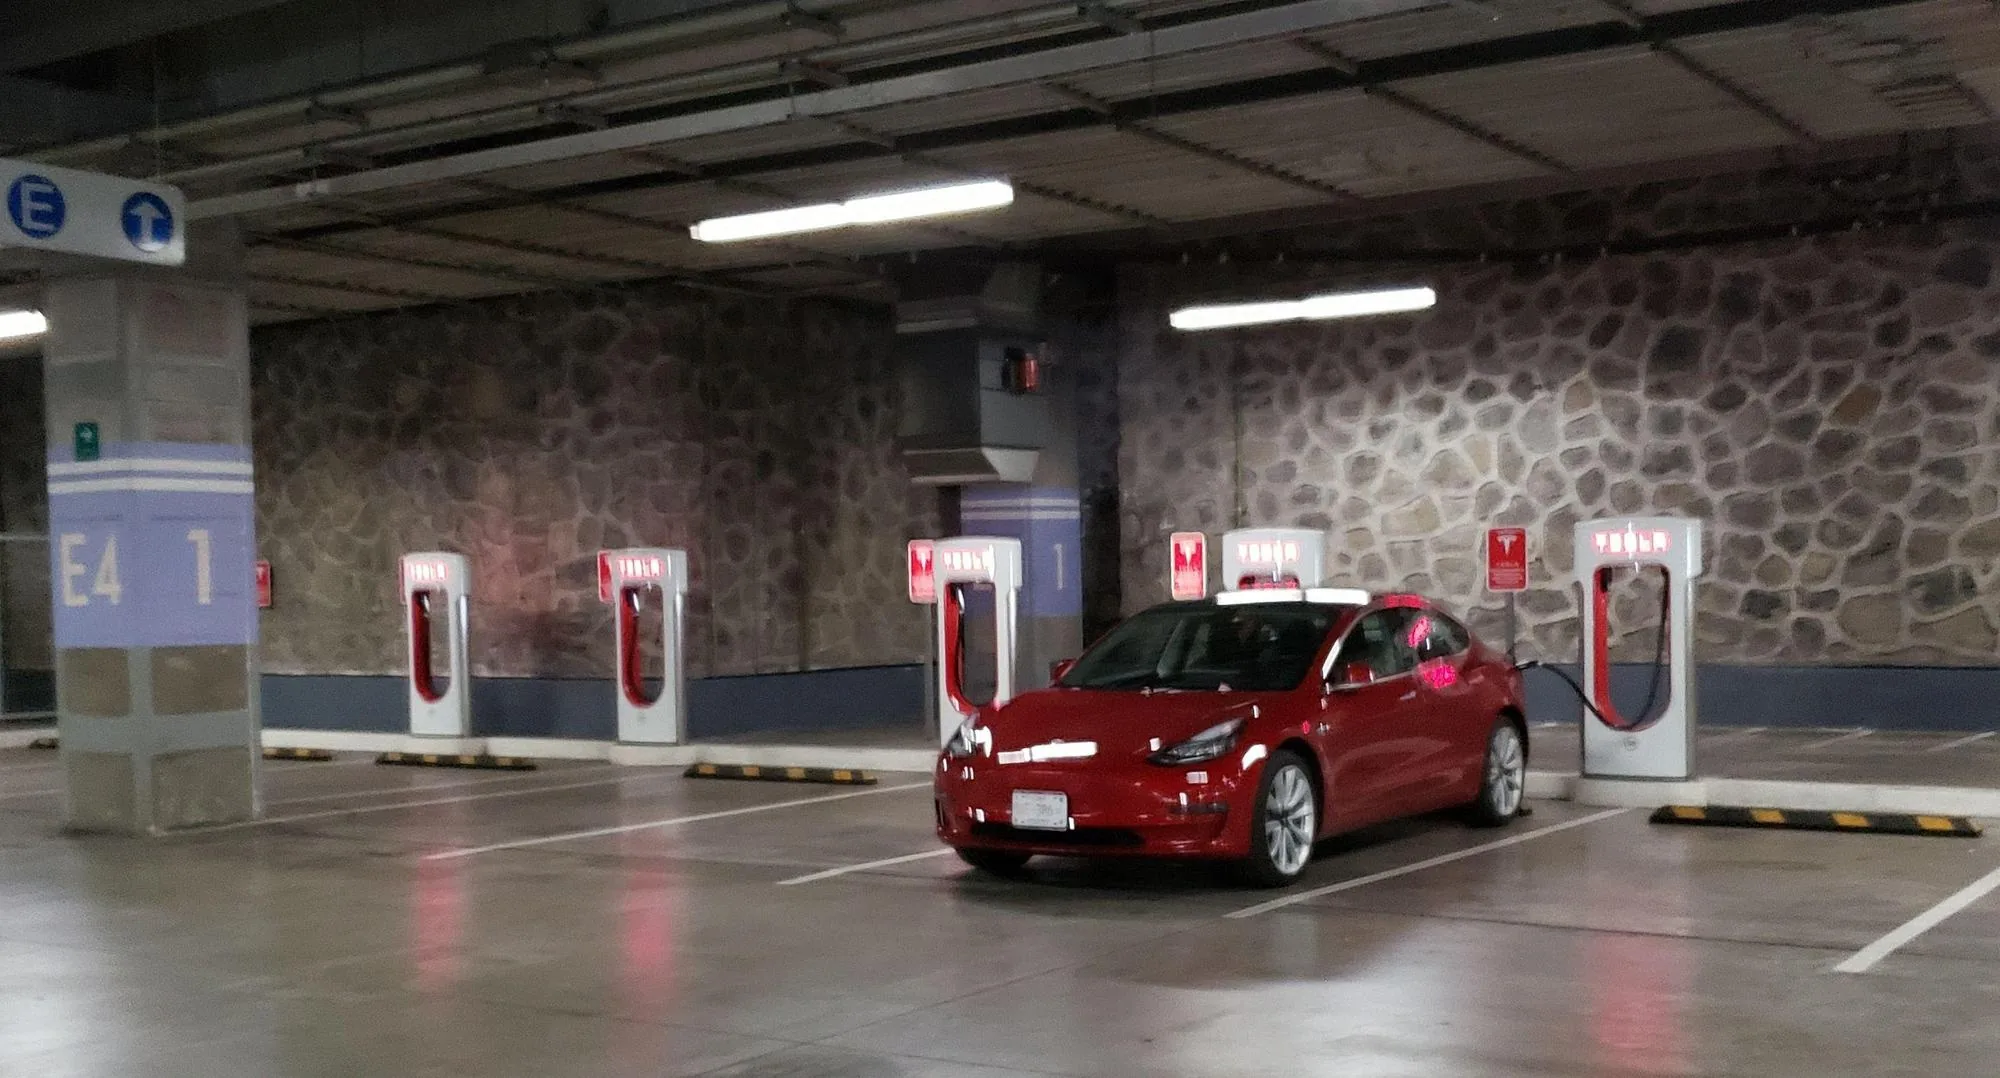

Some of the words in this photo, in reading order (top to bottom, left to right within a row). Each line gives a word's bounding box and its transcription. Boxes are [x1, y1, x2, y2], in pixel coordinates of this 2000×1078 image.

[20, 182, 57, 231] E
[1595, 531, 1668, 552] TLA
[60, 533, 121, 606] E4
[187, 529, 211, 604] 1
[618, 558, 661, 577] TLA
[944, 550, 994, 570] TLA
